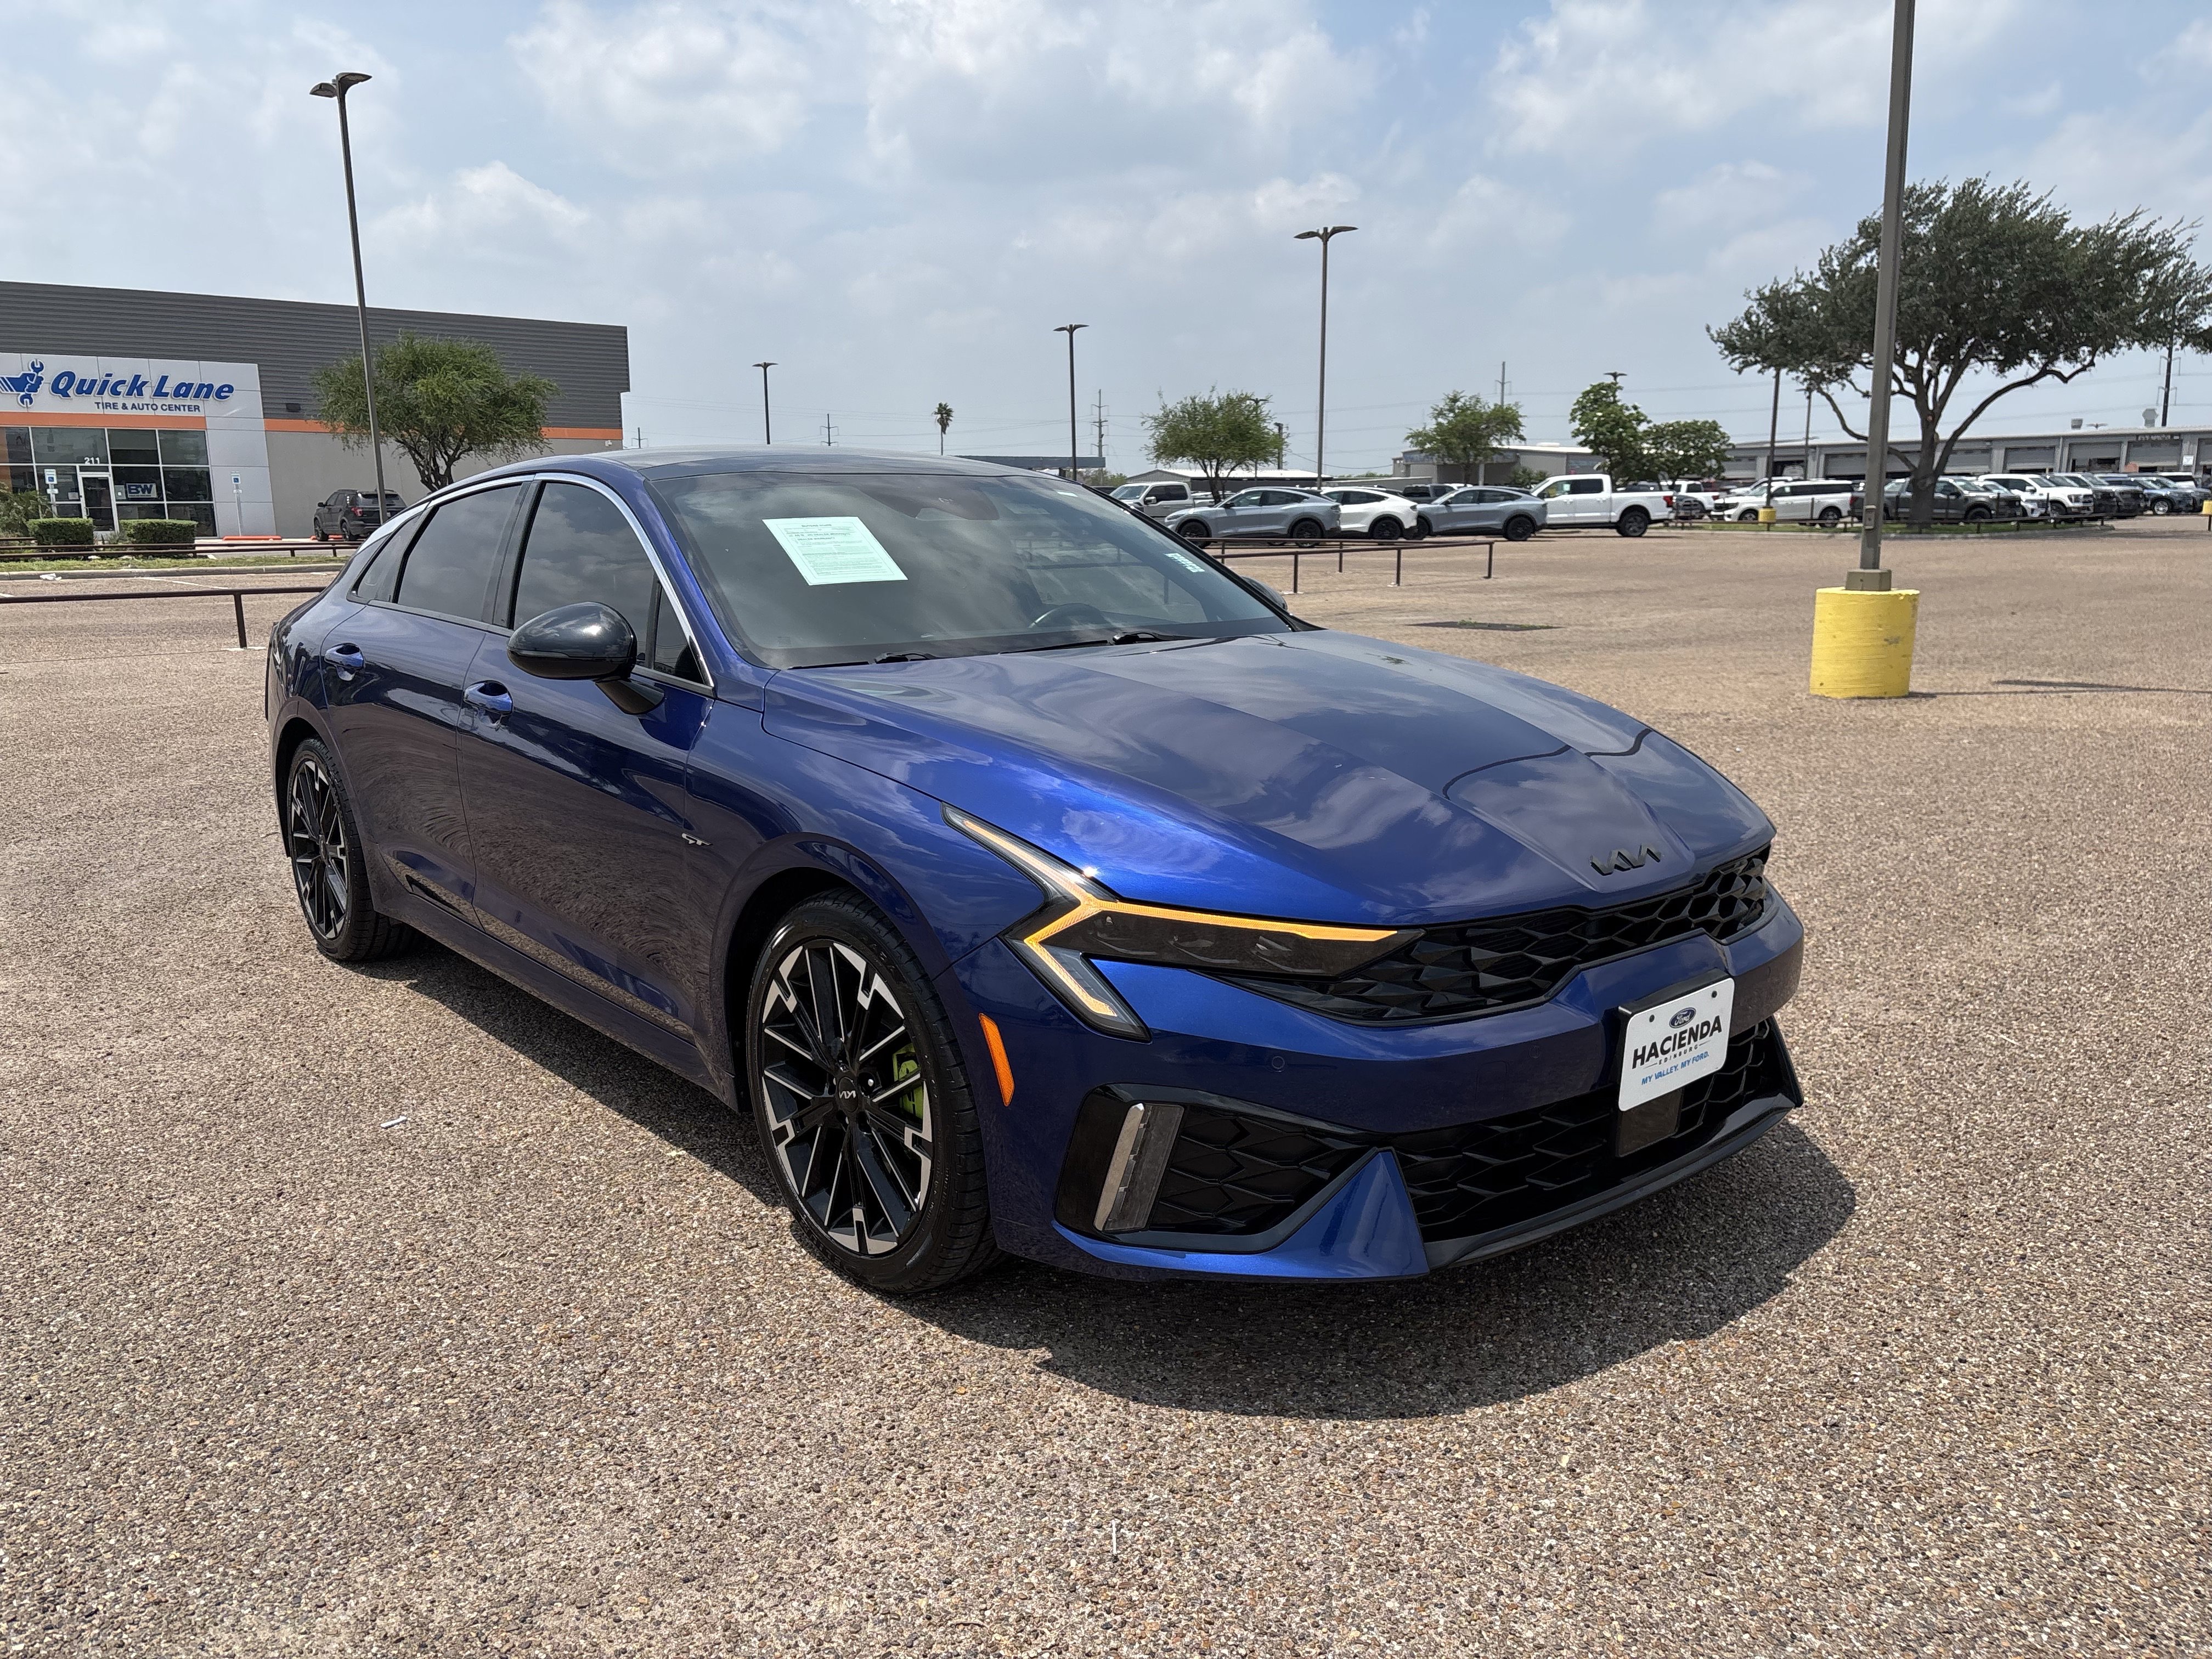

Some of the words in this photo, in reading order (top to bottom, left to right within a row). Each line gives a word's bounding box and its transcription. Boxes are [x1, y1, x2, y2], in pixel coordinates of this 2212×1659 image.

[50, 370, 149, 398] Quick
[153, 375, 234, 400] Lane
[94, 402, 119, 410] TIRE
[131, 403, 159, 411] AUTO
[160, 404, 201, 412] CENTER
[1674, 1011, 1692, 1026] Ford
[1632, 1015, 1722, 1069] HACIENDA
[1658, 1044, 1698, 1065] EDINBURG
[1641, 1074, 1652, 1085] MY
[1681, 1058, 1691, 1069] MY
[1692, 1051, 1709, 1064] FORD.
